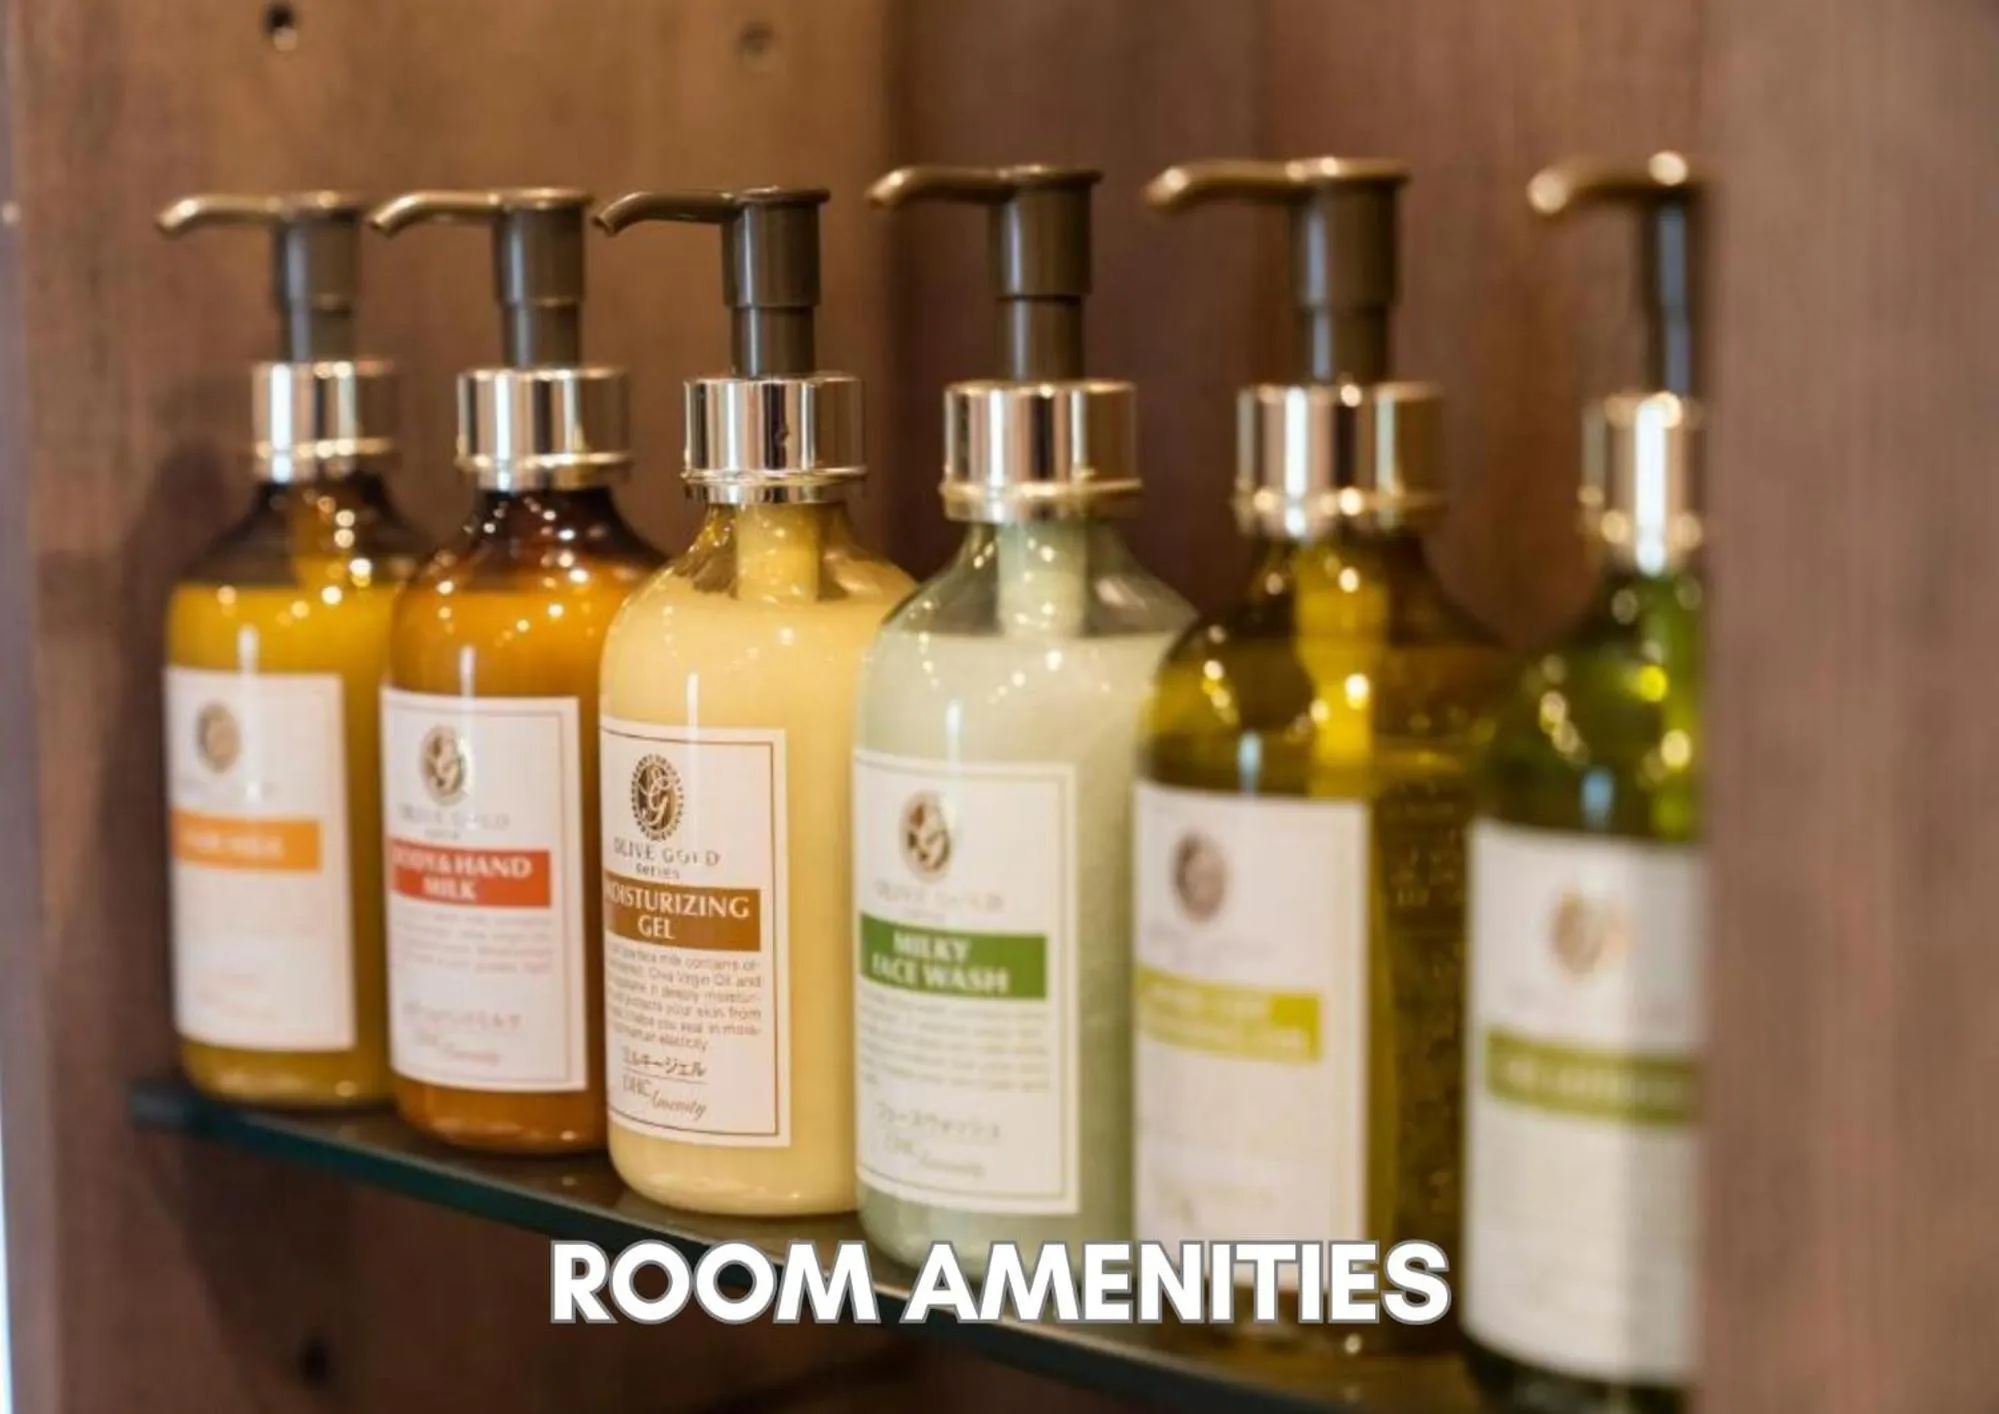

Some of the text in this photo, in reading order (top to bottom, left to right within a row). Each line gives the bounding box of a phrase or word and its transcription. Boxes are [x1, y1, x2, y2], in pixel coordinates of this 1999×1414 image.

[637, 914, 677, 940] GEL
[893, 930, 972, 962] MILKY
[922, 963, 1008, 993] WASH
